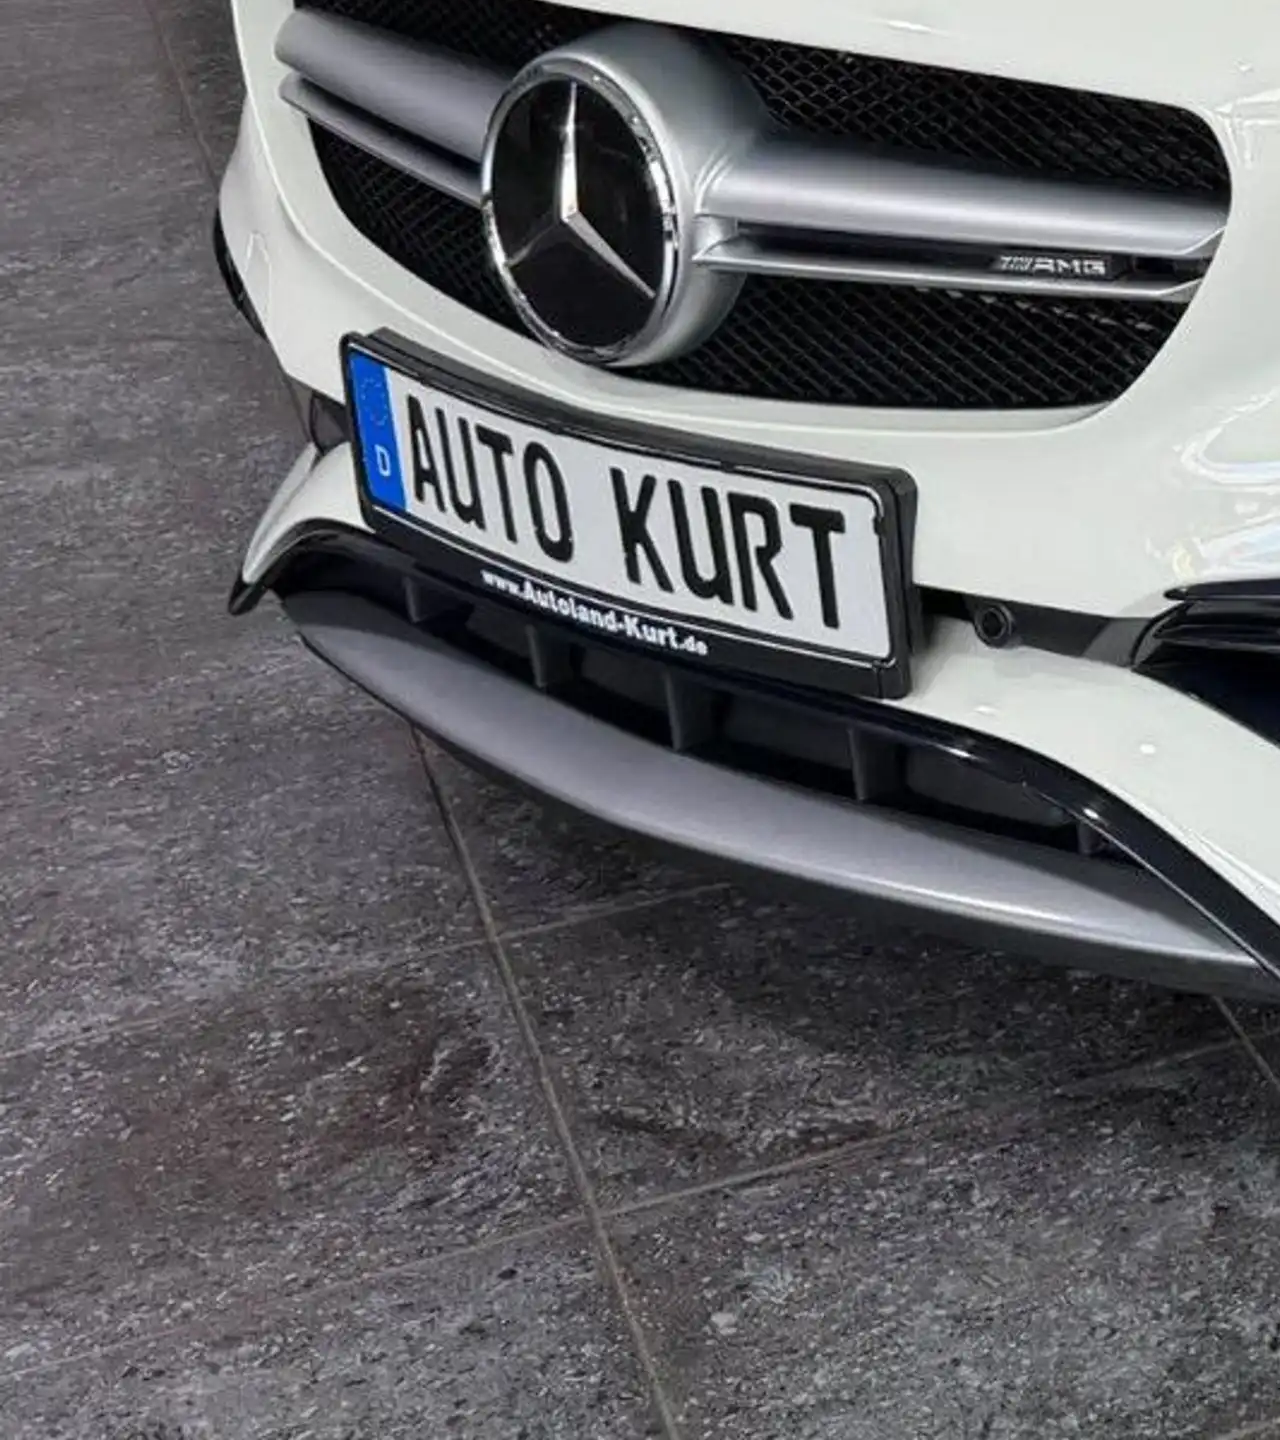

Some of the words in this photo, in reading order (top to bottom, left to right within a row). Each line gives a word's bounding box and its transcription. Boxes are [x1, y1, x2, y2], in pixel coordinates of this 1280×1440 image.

[374, 443, 392, 478] D
[404, 393, 574, 564] AUTO
[610, 466, 847, 631] KURT
[481, 568, 709, 657] www.Autoland-Kurt.de
